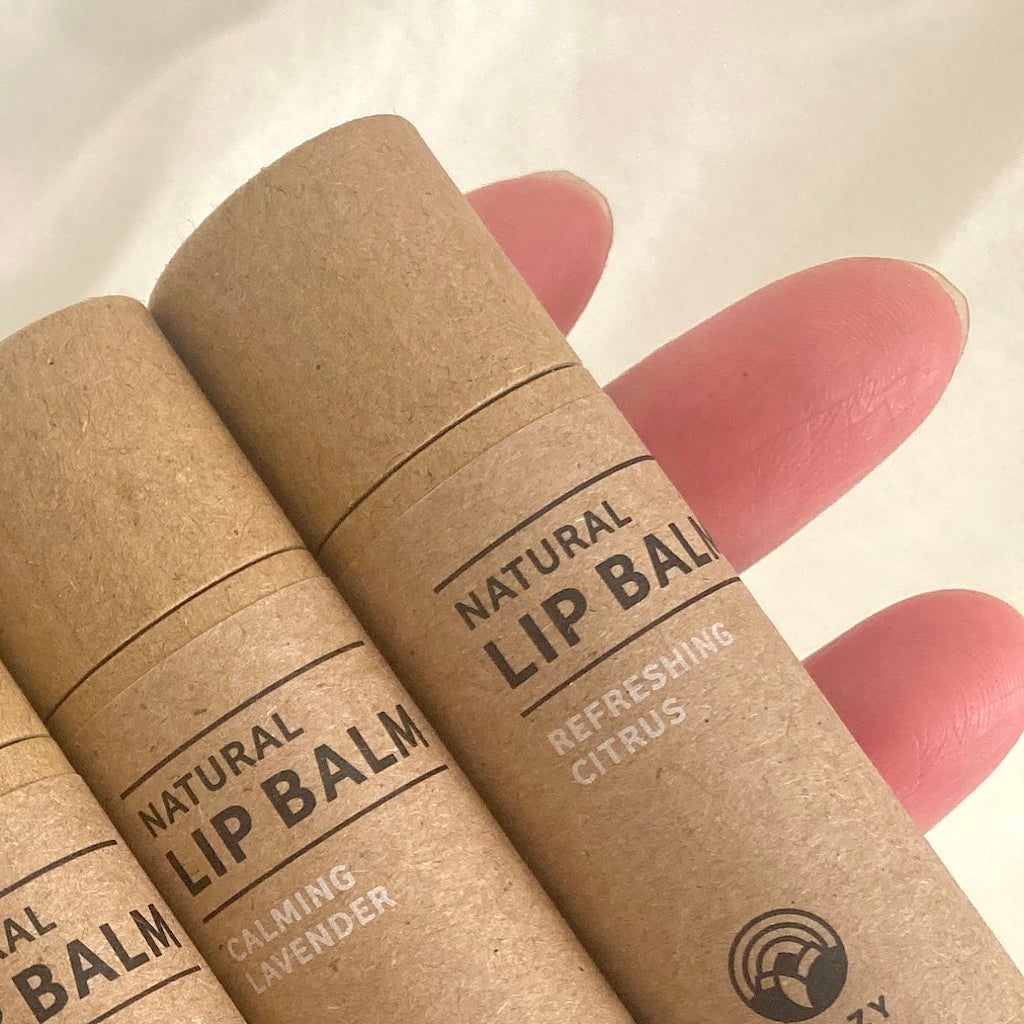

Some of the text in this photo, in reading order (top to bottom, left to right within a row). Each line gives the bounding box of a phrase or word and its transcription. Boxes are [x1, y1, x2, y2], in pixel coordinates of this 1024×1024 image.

[454, 500, 632, 631] NATURAL
[483, 588, 588, 689] LIP
[547, 622, 735, 755] REFRESHING
[138, 712, 304, 838] NATURAL
[166, 704, 429, 897] LIP BALM
[571, 697, 687, 786] CITRUS
[12, 904, 182, 1024] BALM
[226, 864, 356, 962] CALMING
[244, 885, 398, 995] LAVENDER
